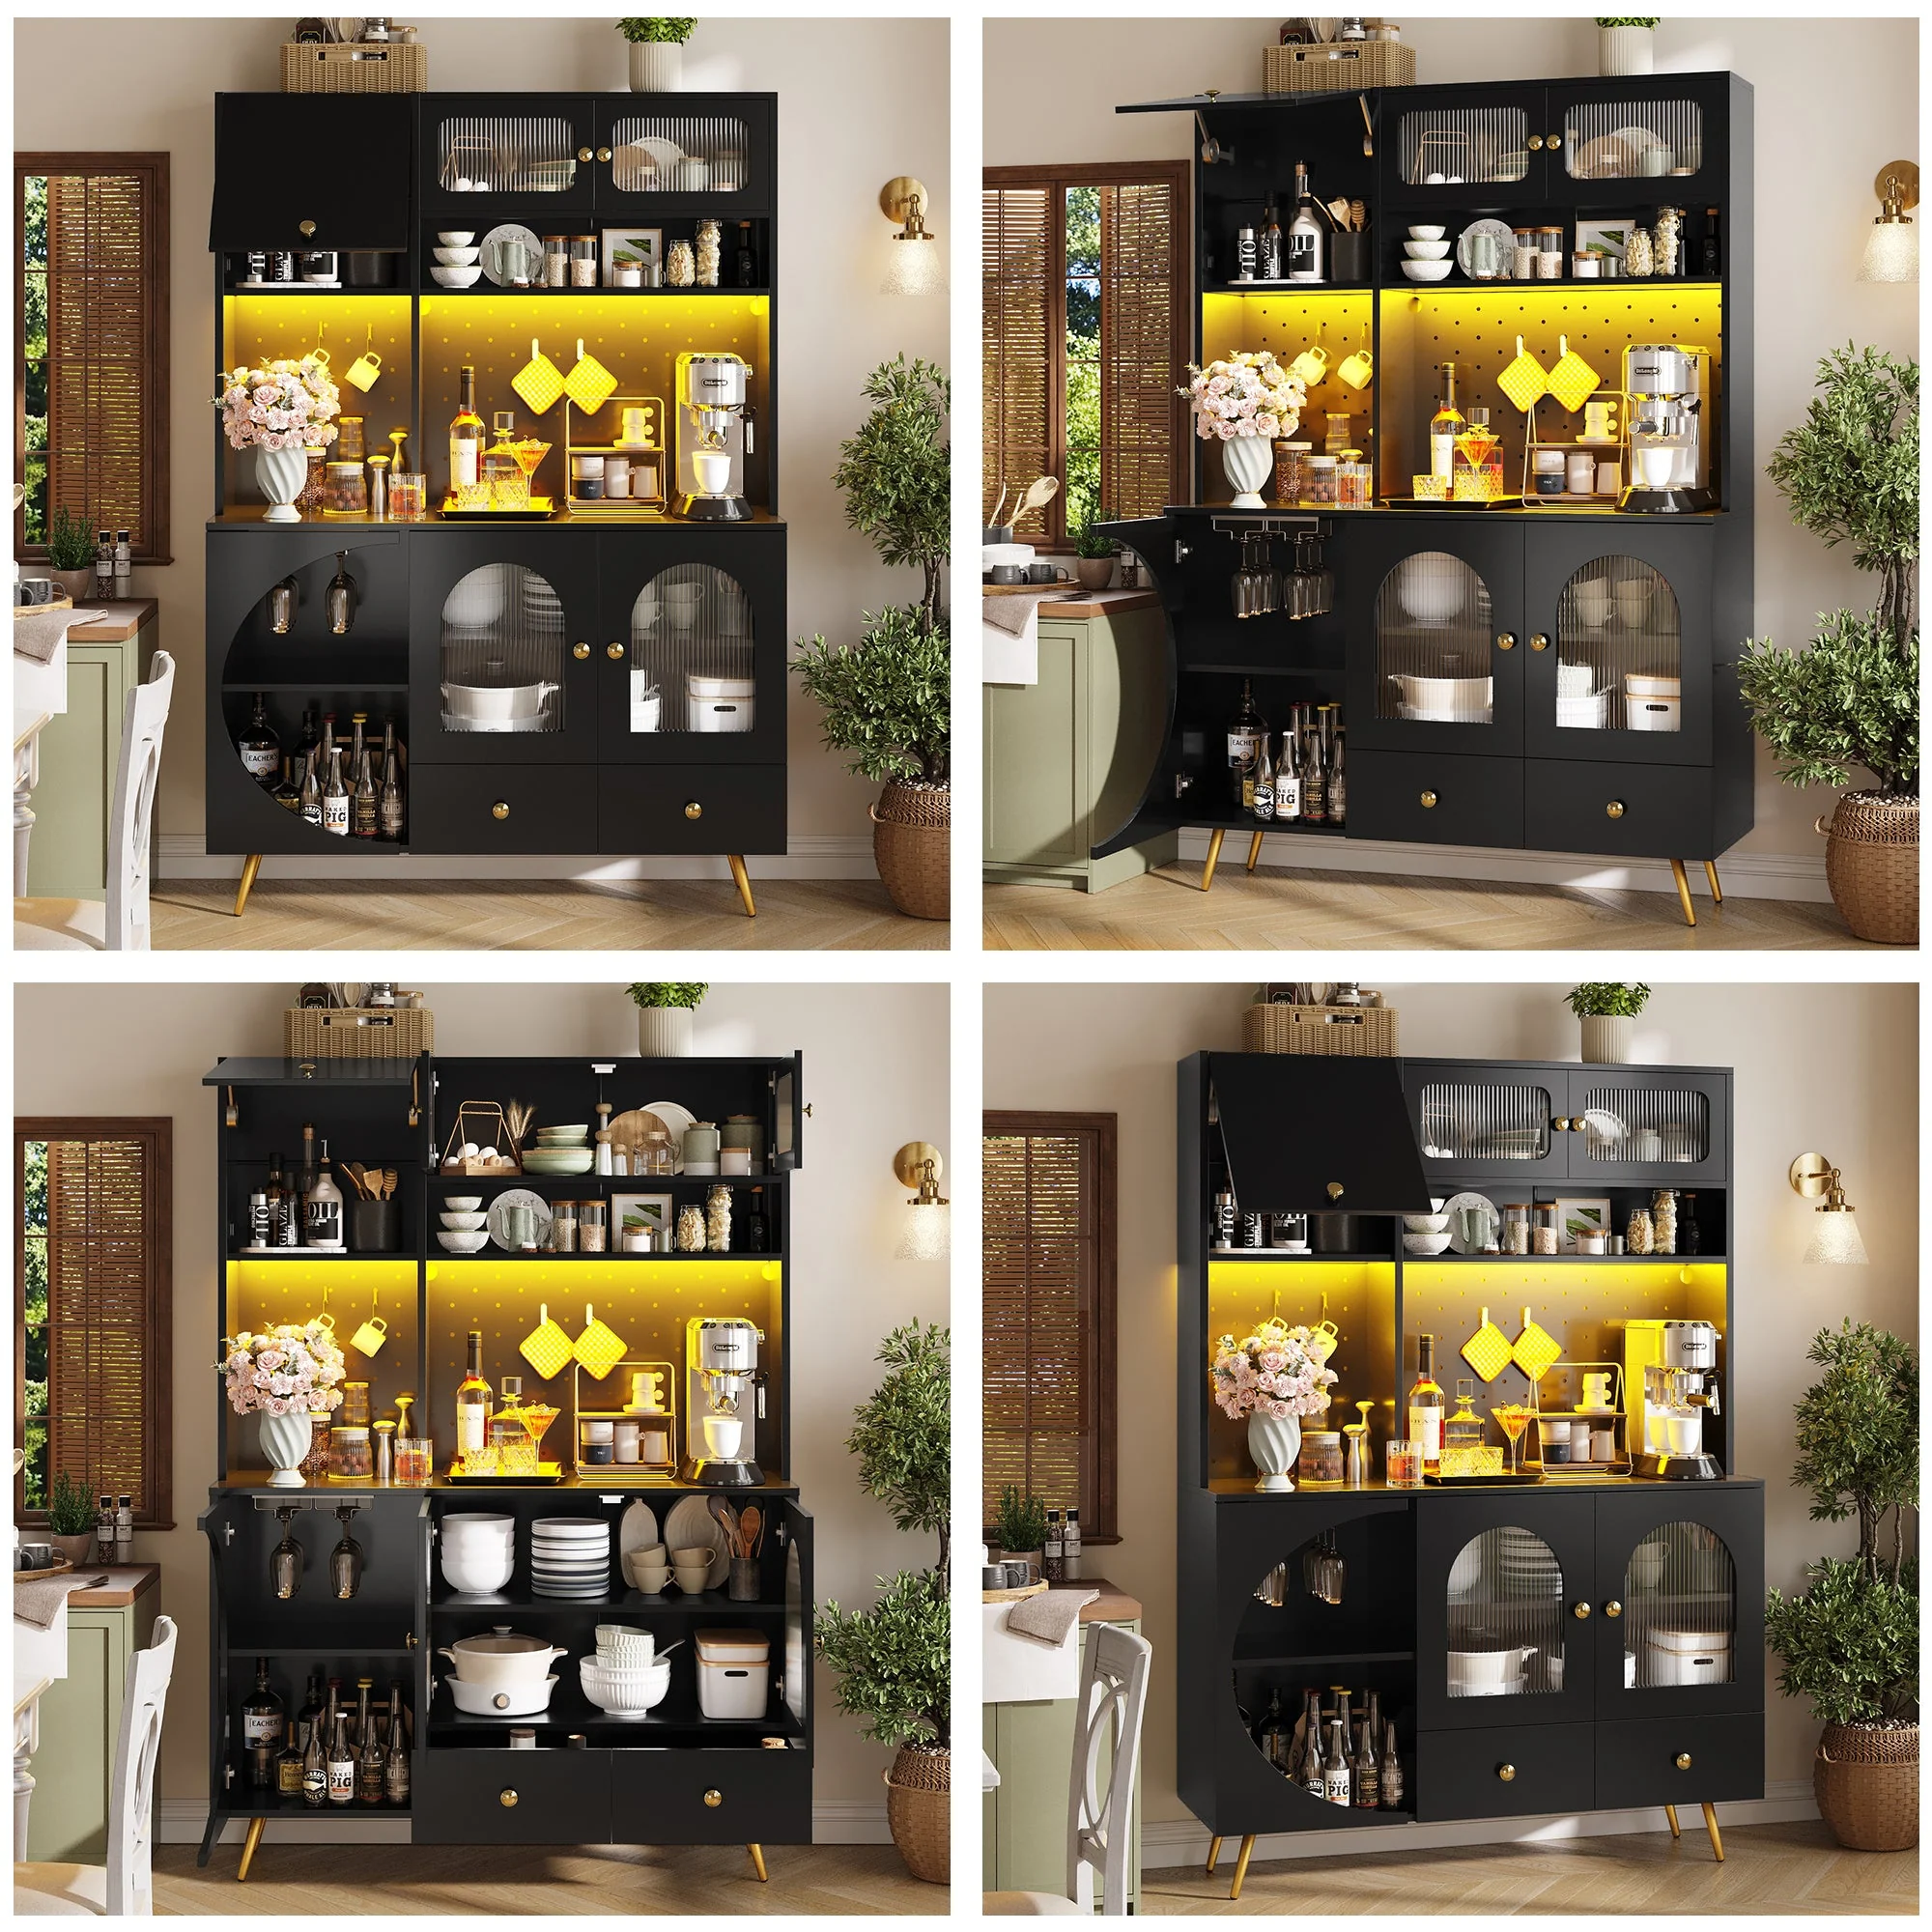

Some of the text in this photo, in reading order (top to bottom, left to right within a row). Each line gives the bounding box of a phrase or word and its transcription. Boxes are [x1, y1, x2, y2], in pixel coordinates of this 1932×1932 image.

[252, 251, 265, 274] IL
[1242, 240, 1256, 273] OIL
[326, 811, 347, 822] PIG
[256, 1206, 270, 1239] OIL
[1222, 1205, 1235, 1240] OIL
[330, 1777, 353, 1788] PIG
[1327, 1785, 1350, 1796] PIG
